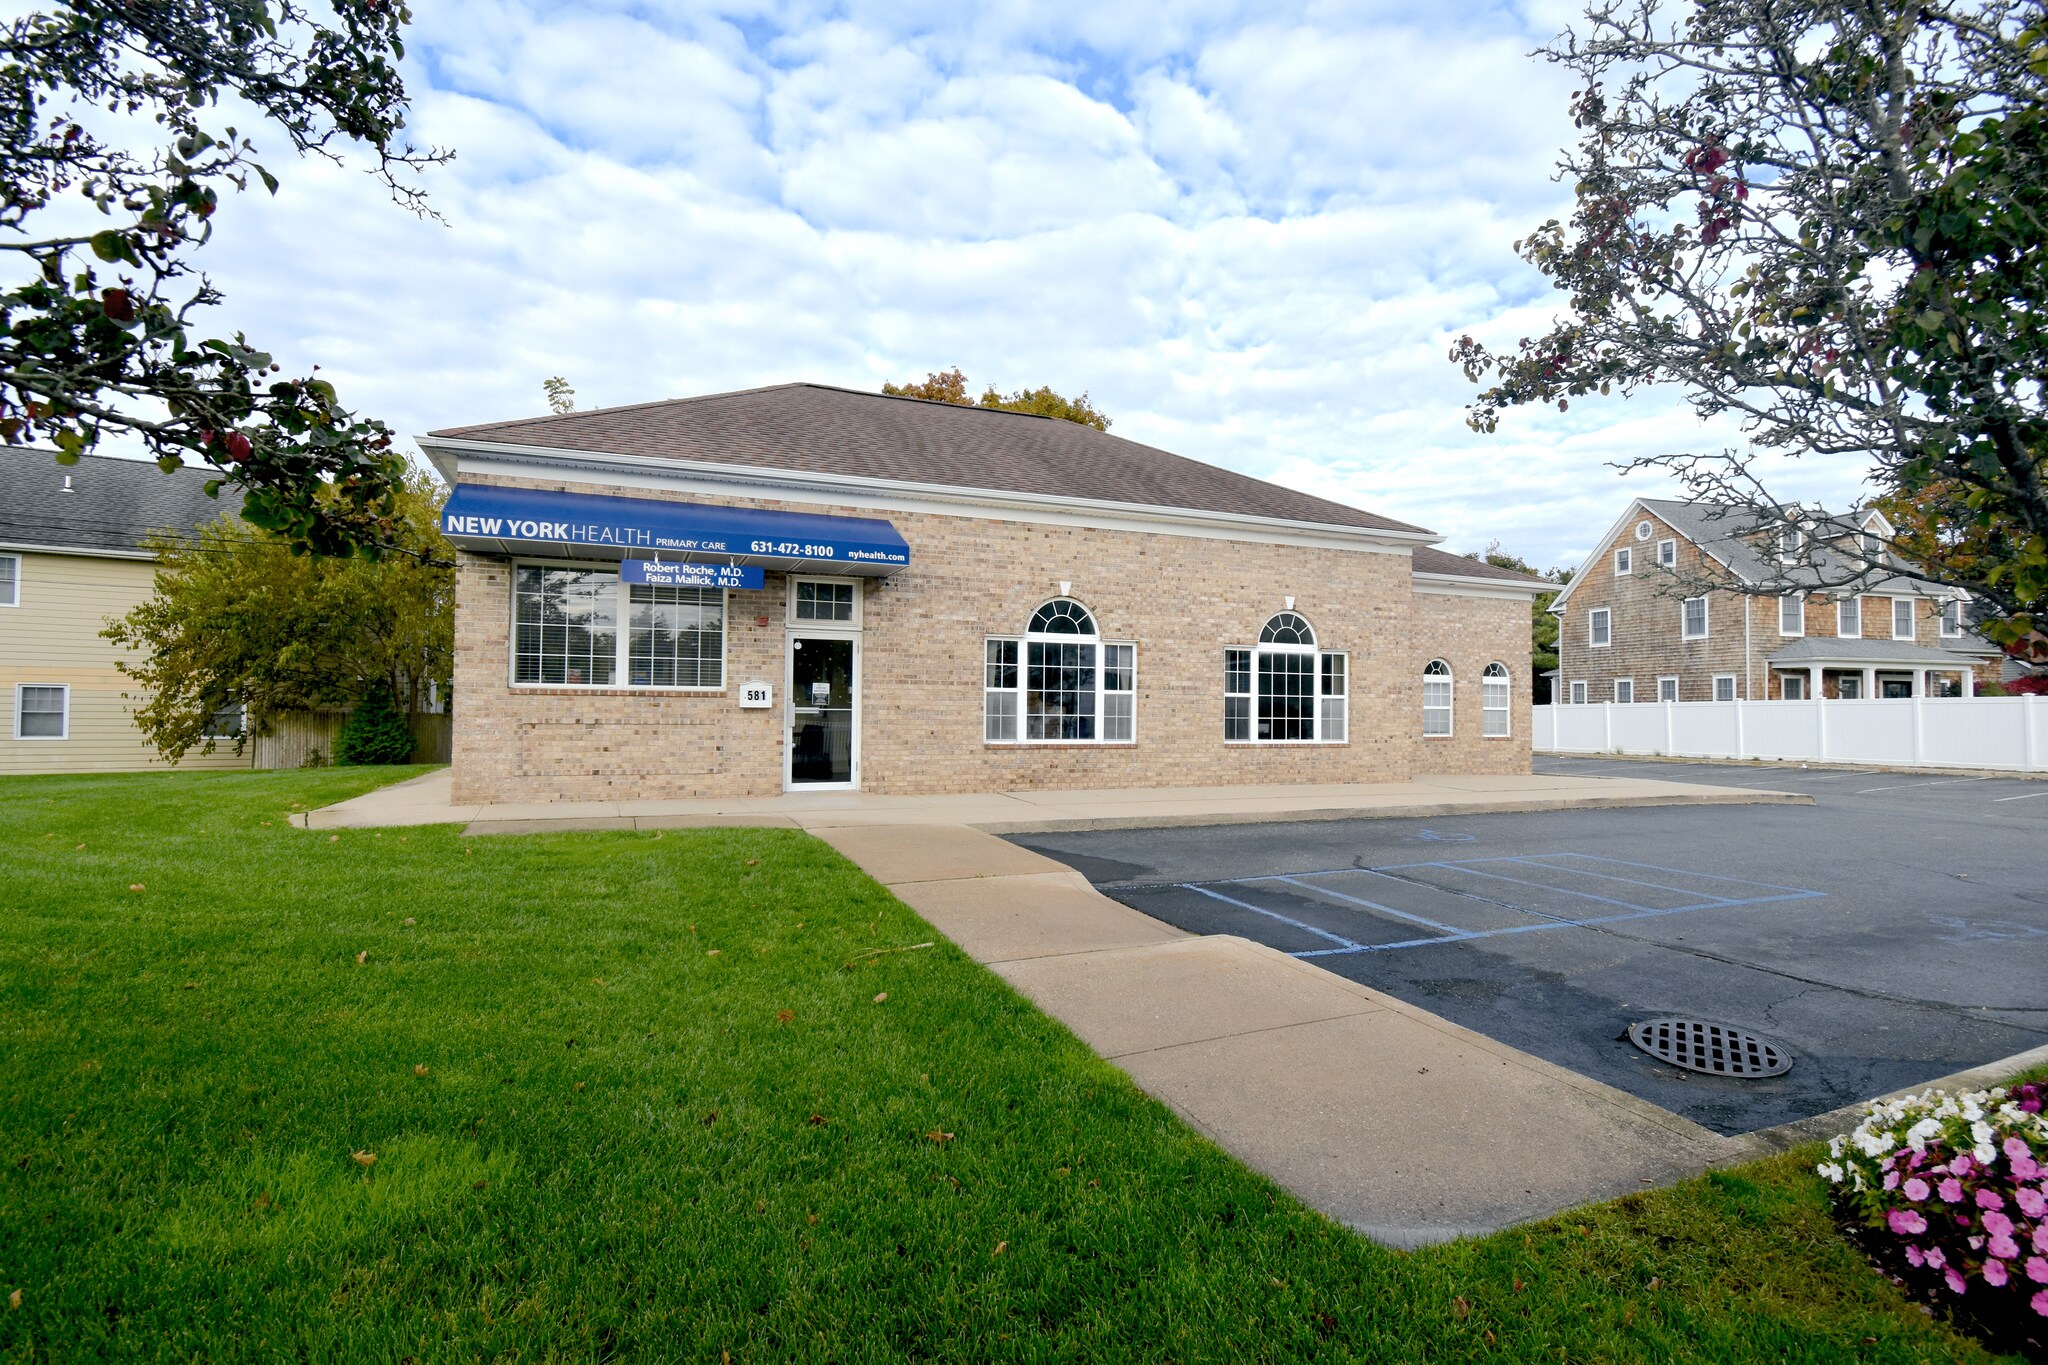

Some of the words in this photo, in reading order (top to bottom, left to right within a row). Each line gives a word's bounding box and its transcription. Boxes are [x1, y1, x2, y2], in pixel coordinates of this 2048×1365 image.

[448, 515, 502, 535] NEW
[507, 519, 569, 540] YORK
[572, 524, 651, 545] HEALTH
[656, 538, 698, 548] PRIMARY
[701, 541, 726, 551] CARE
[751, 541, 834, 557] 631-472-8100
[848, 550, 905, 561] nyhealth.com
[643, 563, 679, 574] Robert
[682, 564, 718, 576] Roche,
[720, 567, 744, 577] M.D.
[645, 573, 672, 583] Faiza
[675, 574, 714, 586] Mallick,
[717, 577, 742, 587] M.D.
[747, 690, 766, 701] 581
